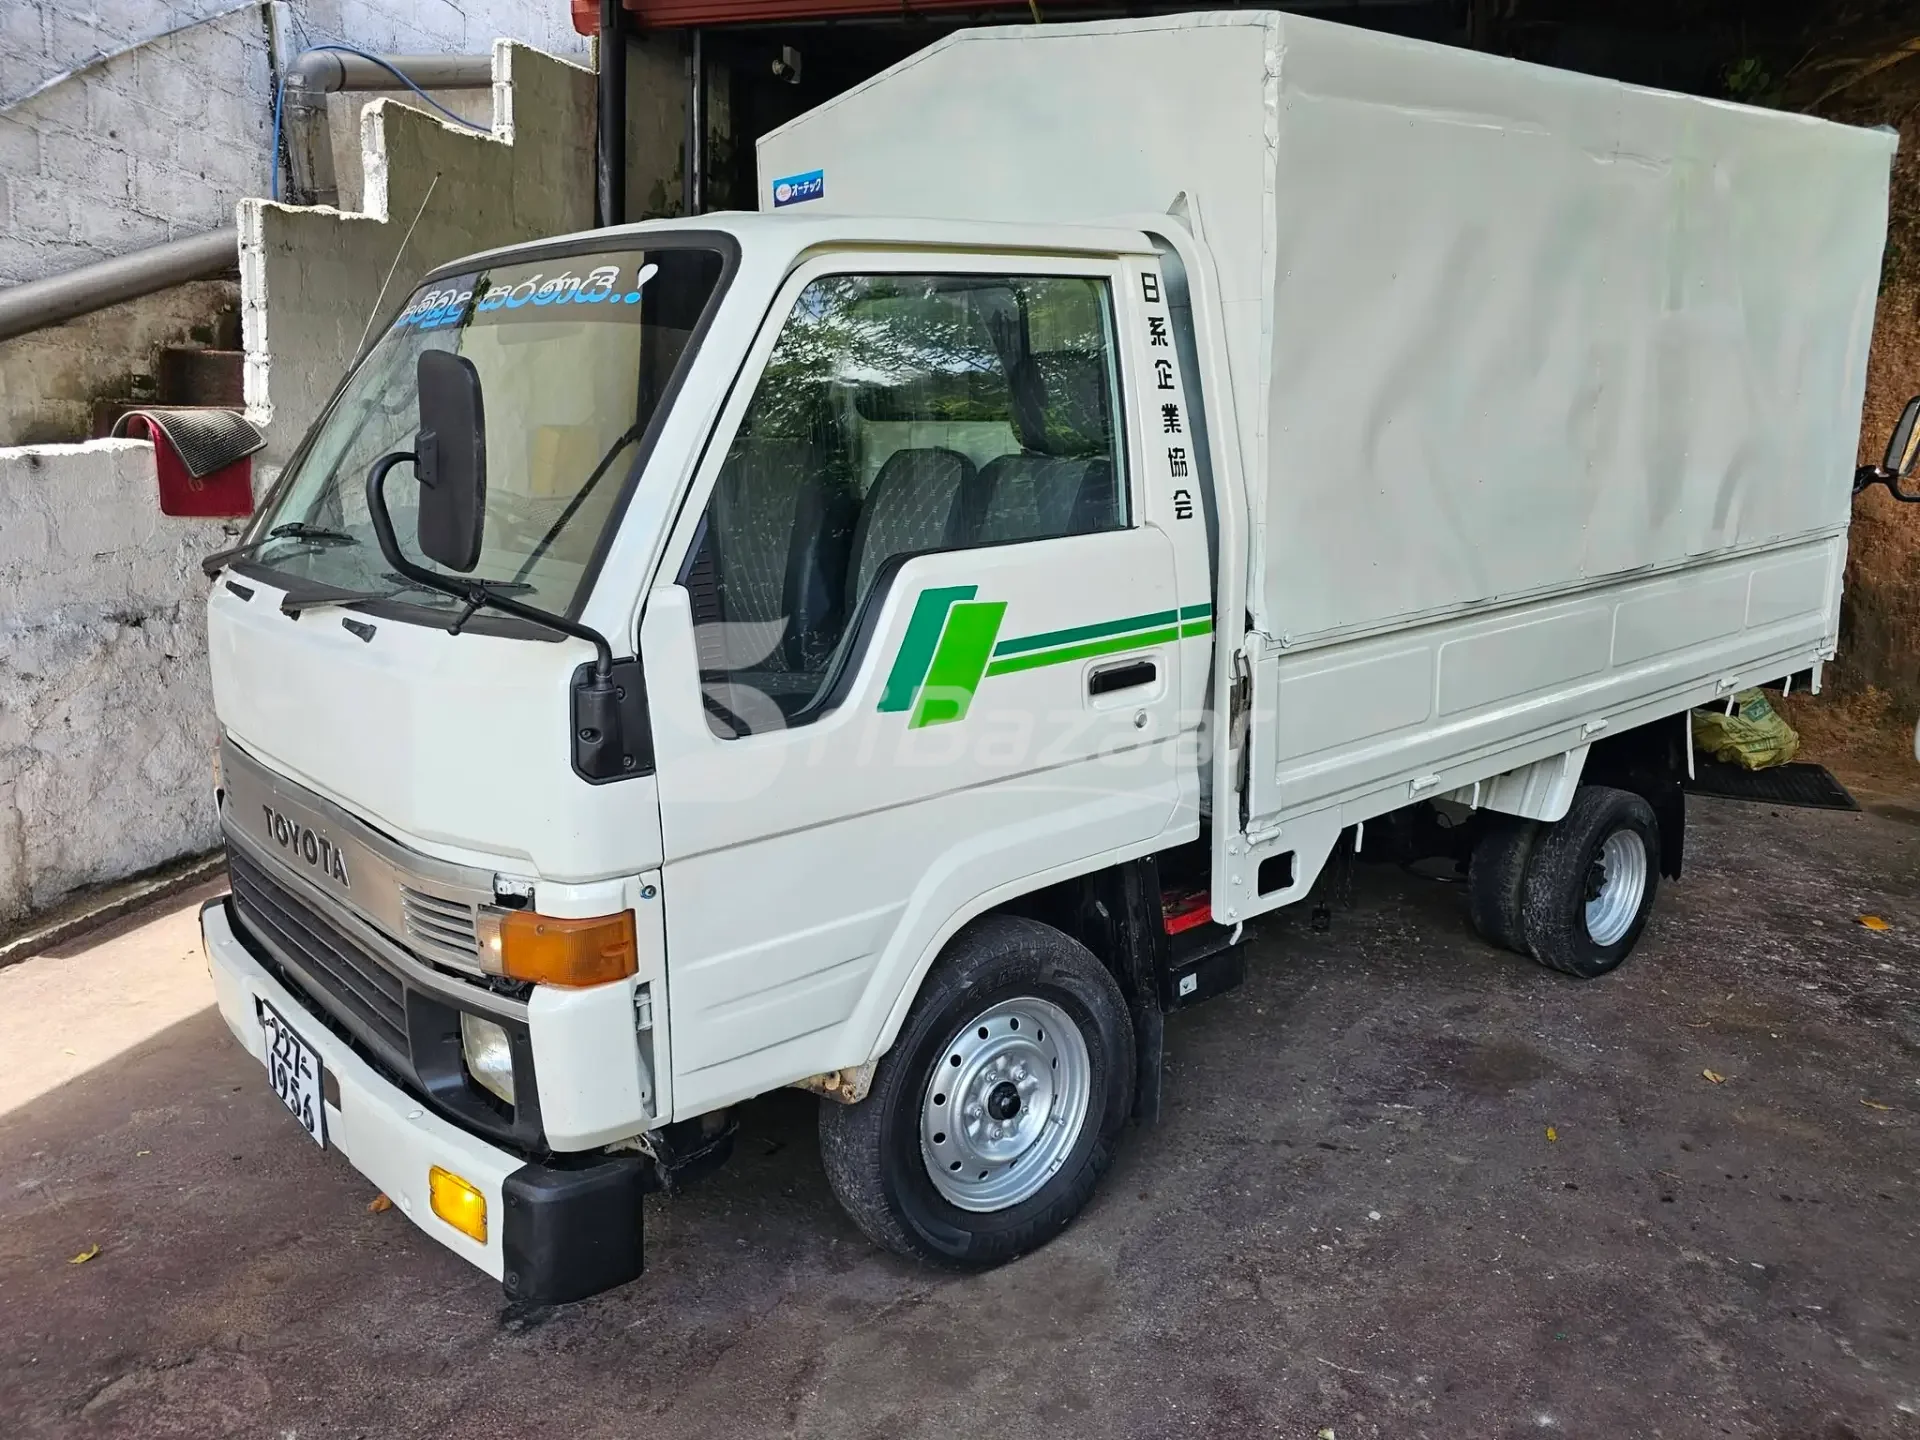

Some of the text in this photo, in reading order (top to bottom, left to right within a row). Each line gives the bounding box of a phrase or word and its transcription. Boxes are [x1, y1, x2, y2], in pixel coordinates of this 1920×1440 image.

[791, 178, 821, 196] オーテック
[1141, 272, 1193, 520] 日系企業協会
[262, 804, 350, 890] TOYOTA
[270, 1052, 315, 1133] 1956
